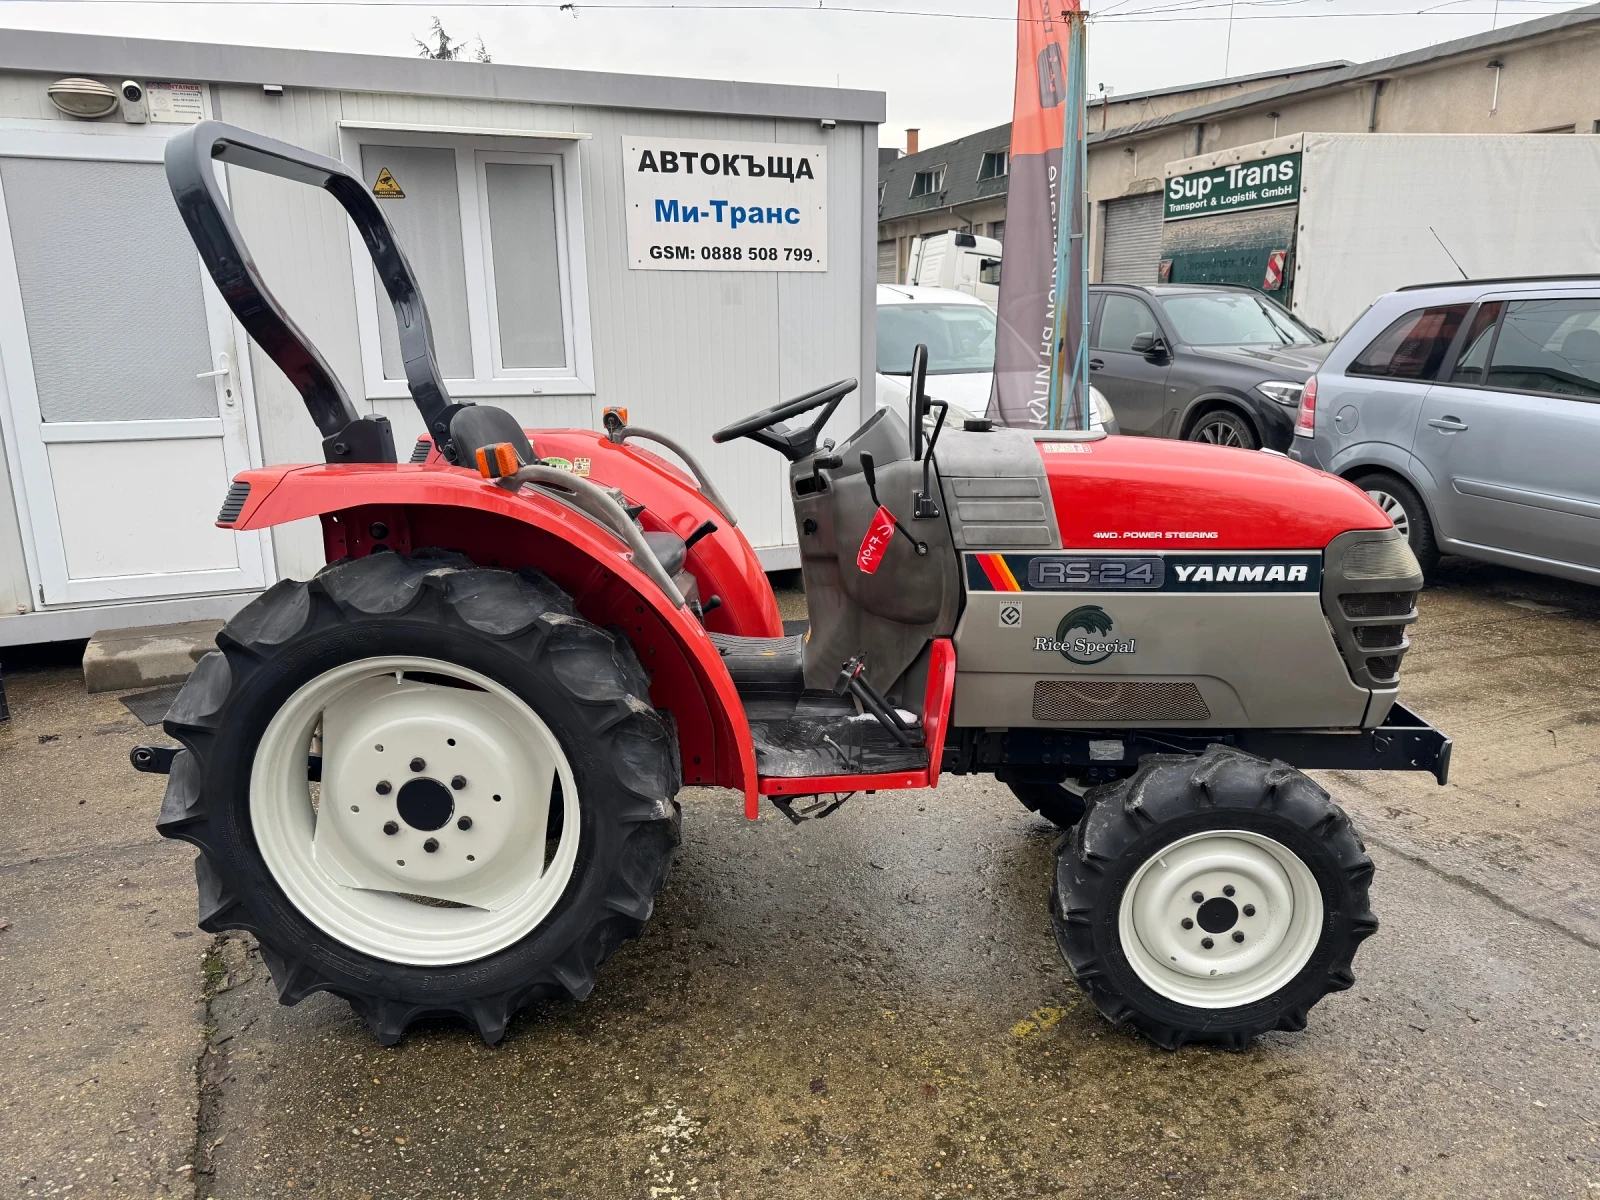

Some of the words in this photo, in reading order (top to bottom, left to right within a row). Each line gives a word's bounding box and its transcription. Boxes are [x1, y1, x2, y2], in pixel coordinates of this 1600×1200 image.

[638, 149, 814, 184] АВТОКЪЩА
[1169, 160, 1294, 200] Sup-Trans
[1169, 199, 1207, 212] Transport
[1210, 197, 1217, 206] &
[1221, 191, 1257, 204] Logistik
[1261, 185, 1292, 198] GmbH
[654, 198, 801, 229] Ми-Транс
[649, 245, 695, 260] GSM:
[701, 246, 742, 261] 0888
[748, 246, 778, 261] 508
[783, 247, 813, 262] 799
[1038, 562, 1154, 584] RS-24
[1174, 564, 1308, 582] YANMAR
[1034, 636, 1070, 652] Rice
[1074, 638, 1135, 655] Special
